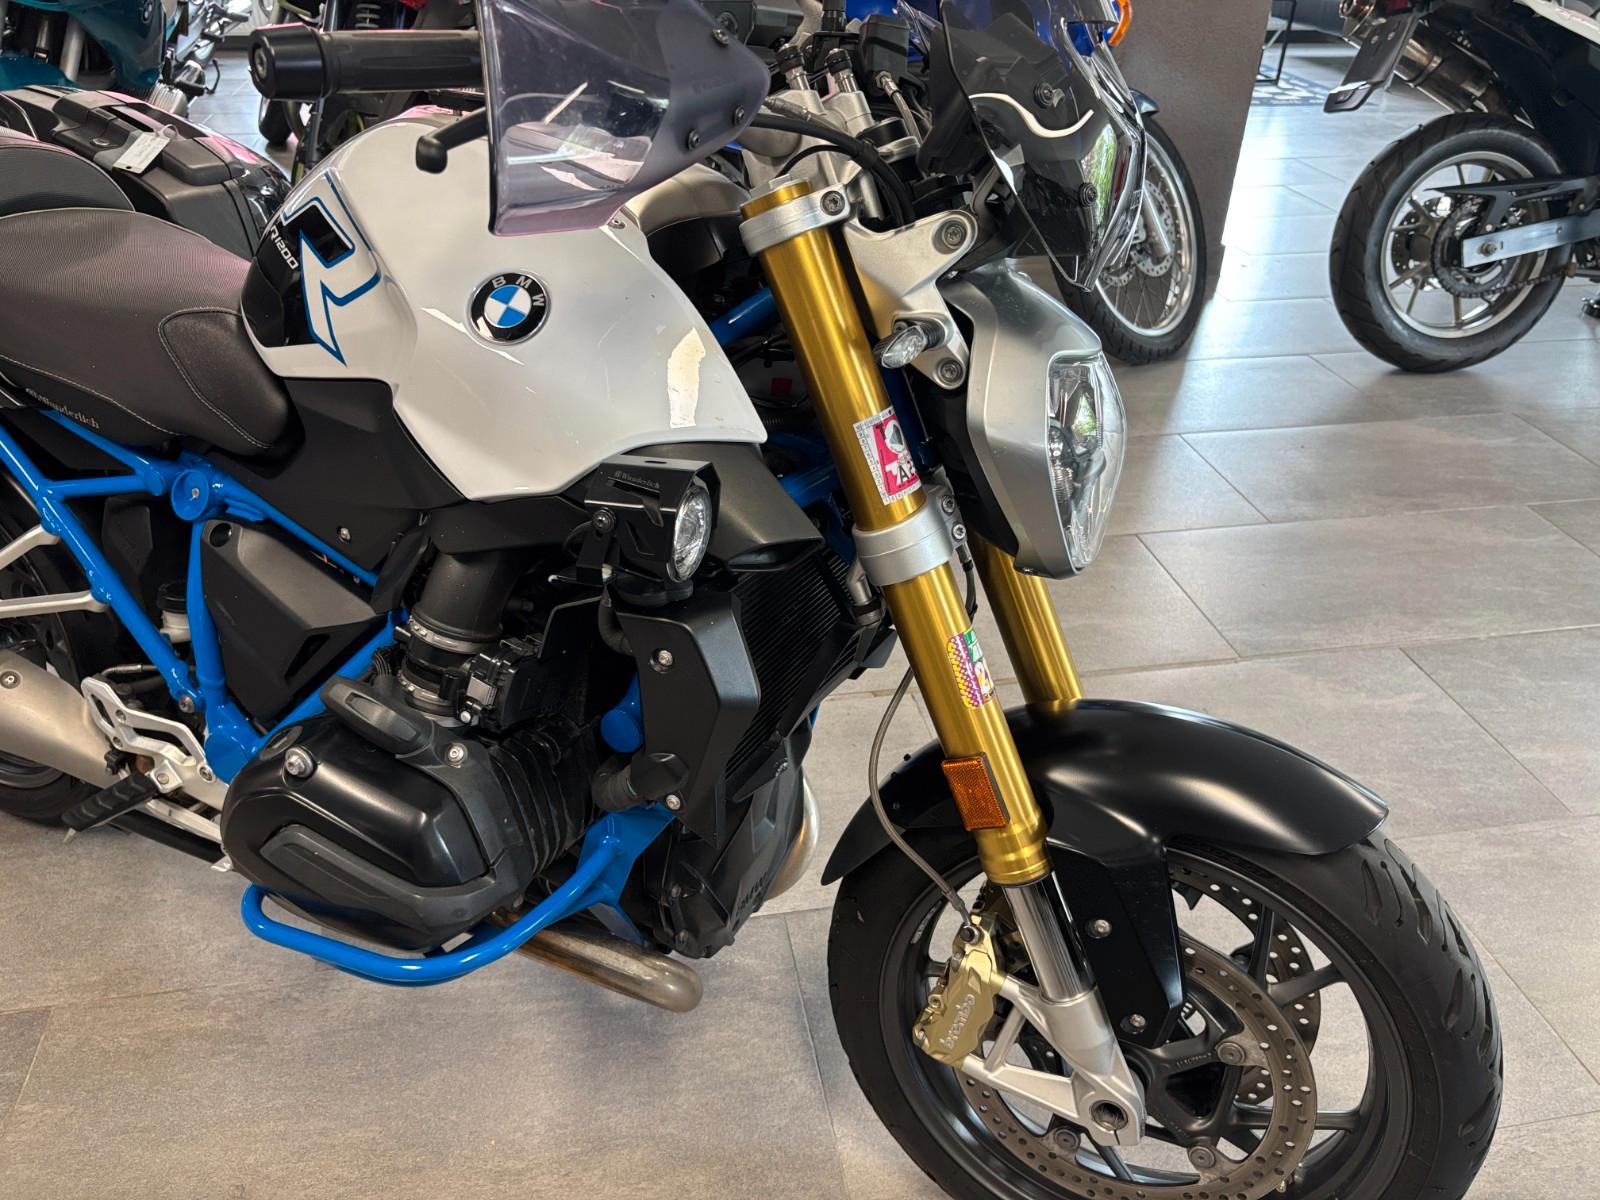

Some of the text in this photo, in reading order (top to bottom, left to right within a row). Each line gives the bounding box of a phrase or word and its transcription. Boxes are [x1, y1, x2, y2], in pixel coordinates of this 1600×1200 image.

[270, 225, 299, 270] R1200
[491, 275, 545, 307] BMW
[939, 993, 977, 1050] brembo
